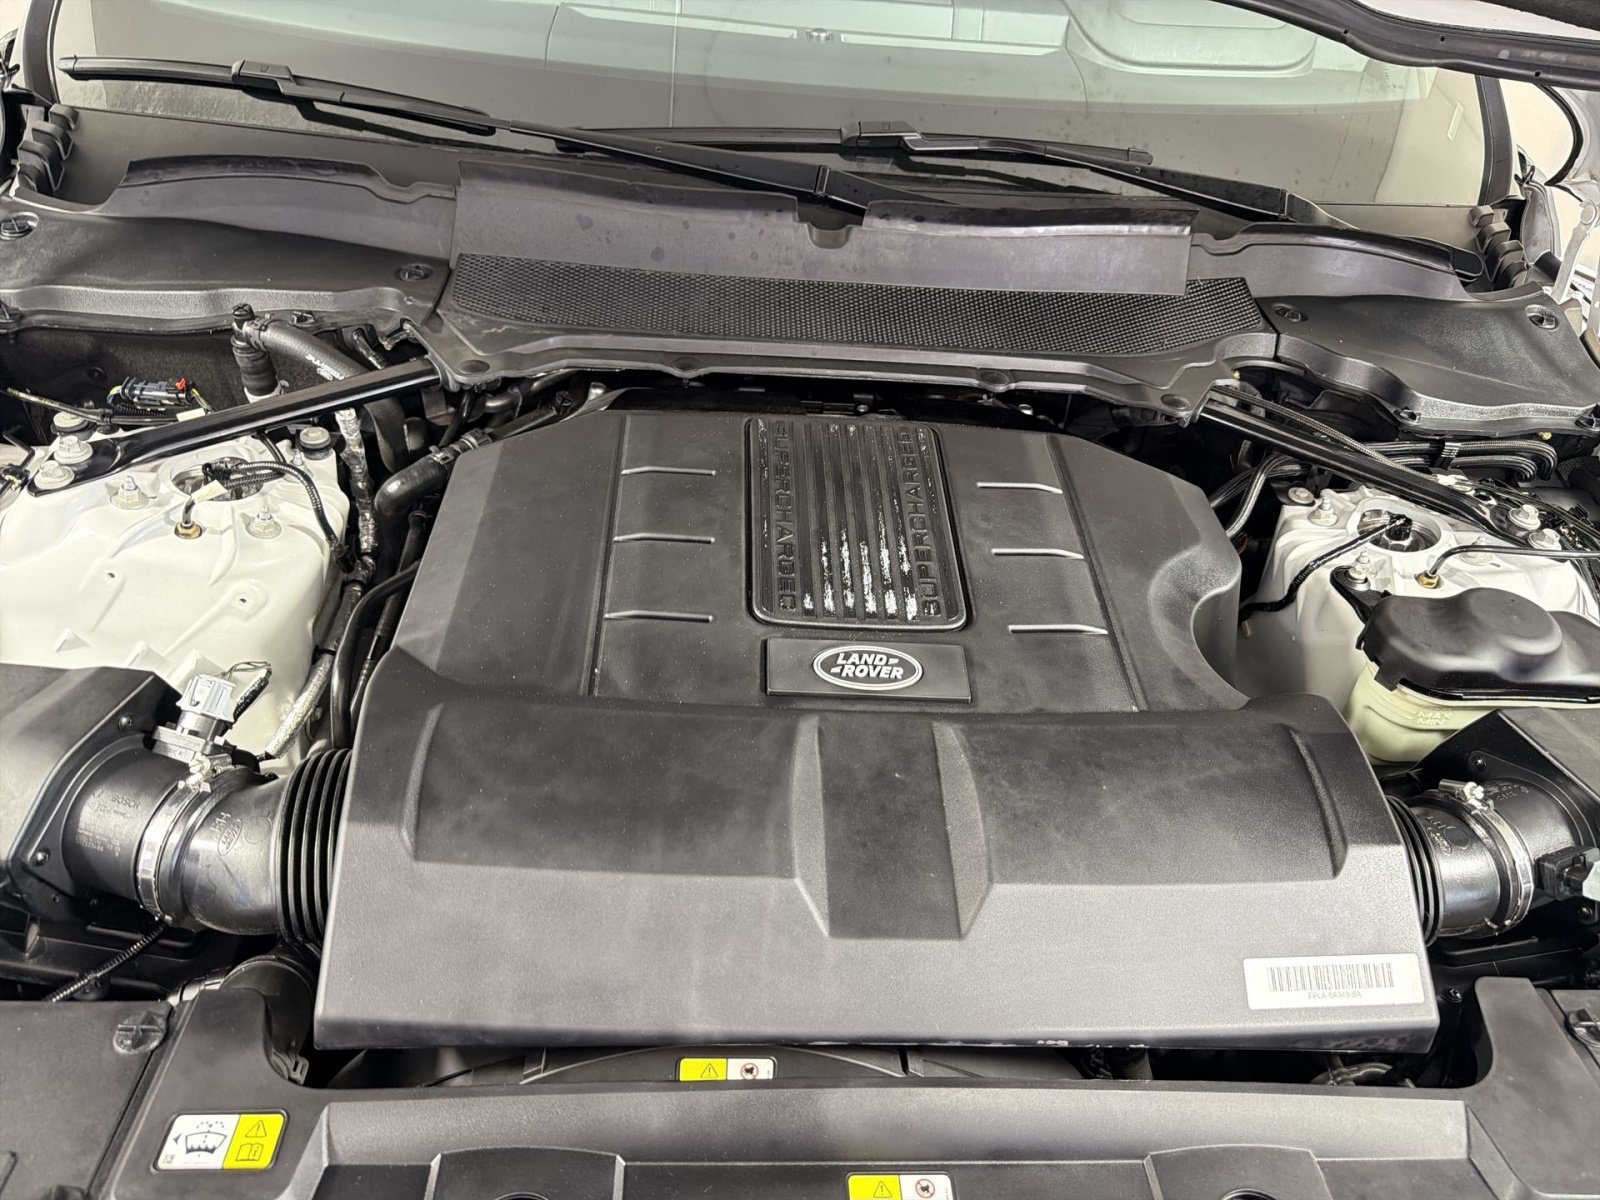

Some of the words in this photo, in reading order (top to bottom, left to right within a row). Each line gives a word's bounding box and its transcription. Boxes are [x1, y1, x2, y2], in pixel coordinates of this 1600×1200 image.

[899, 430, 942, 617] SUPERCHARGED
[836, 653, 887, 666] LAND
[841, 664, 904, 679] ROVER
